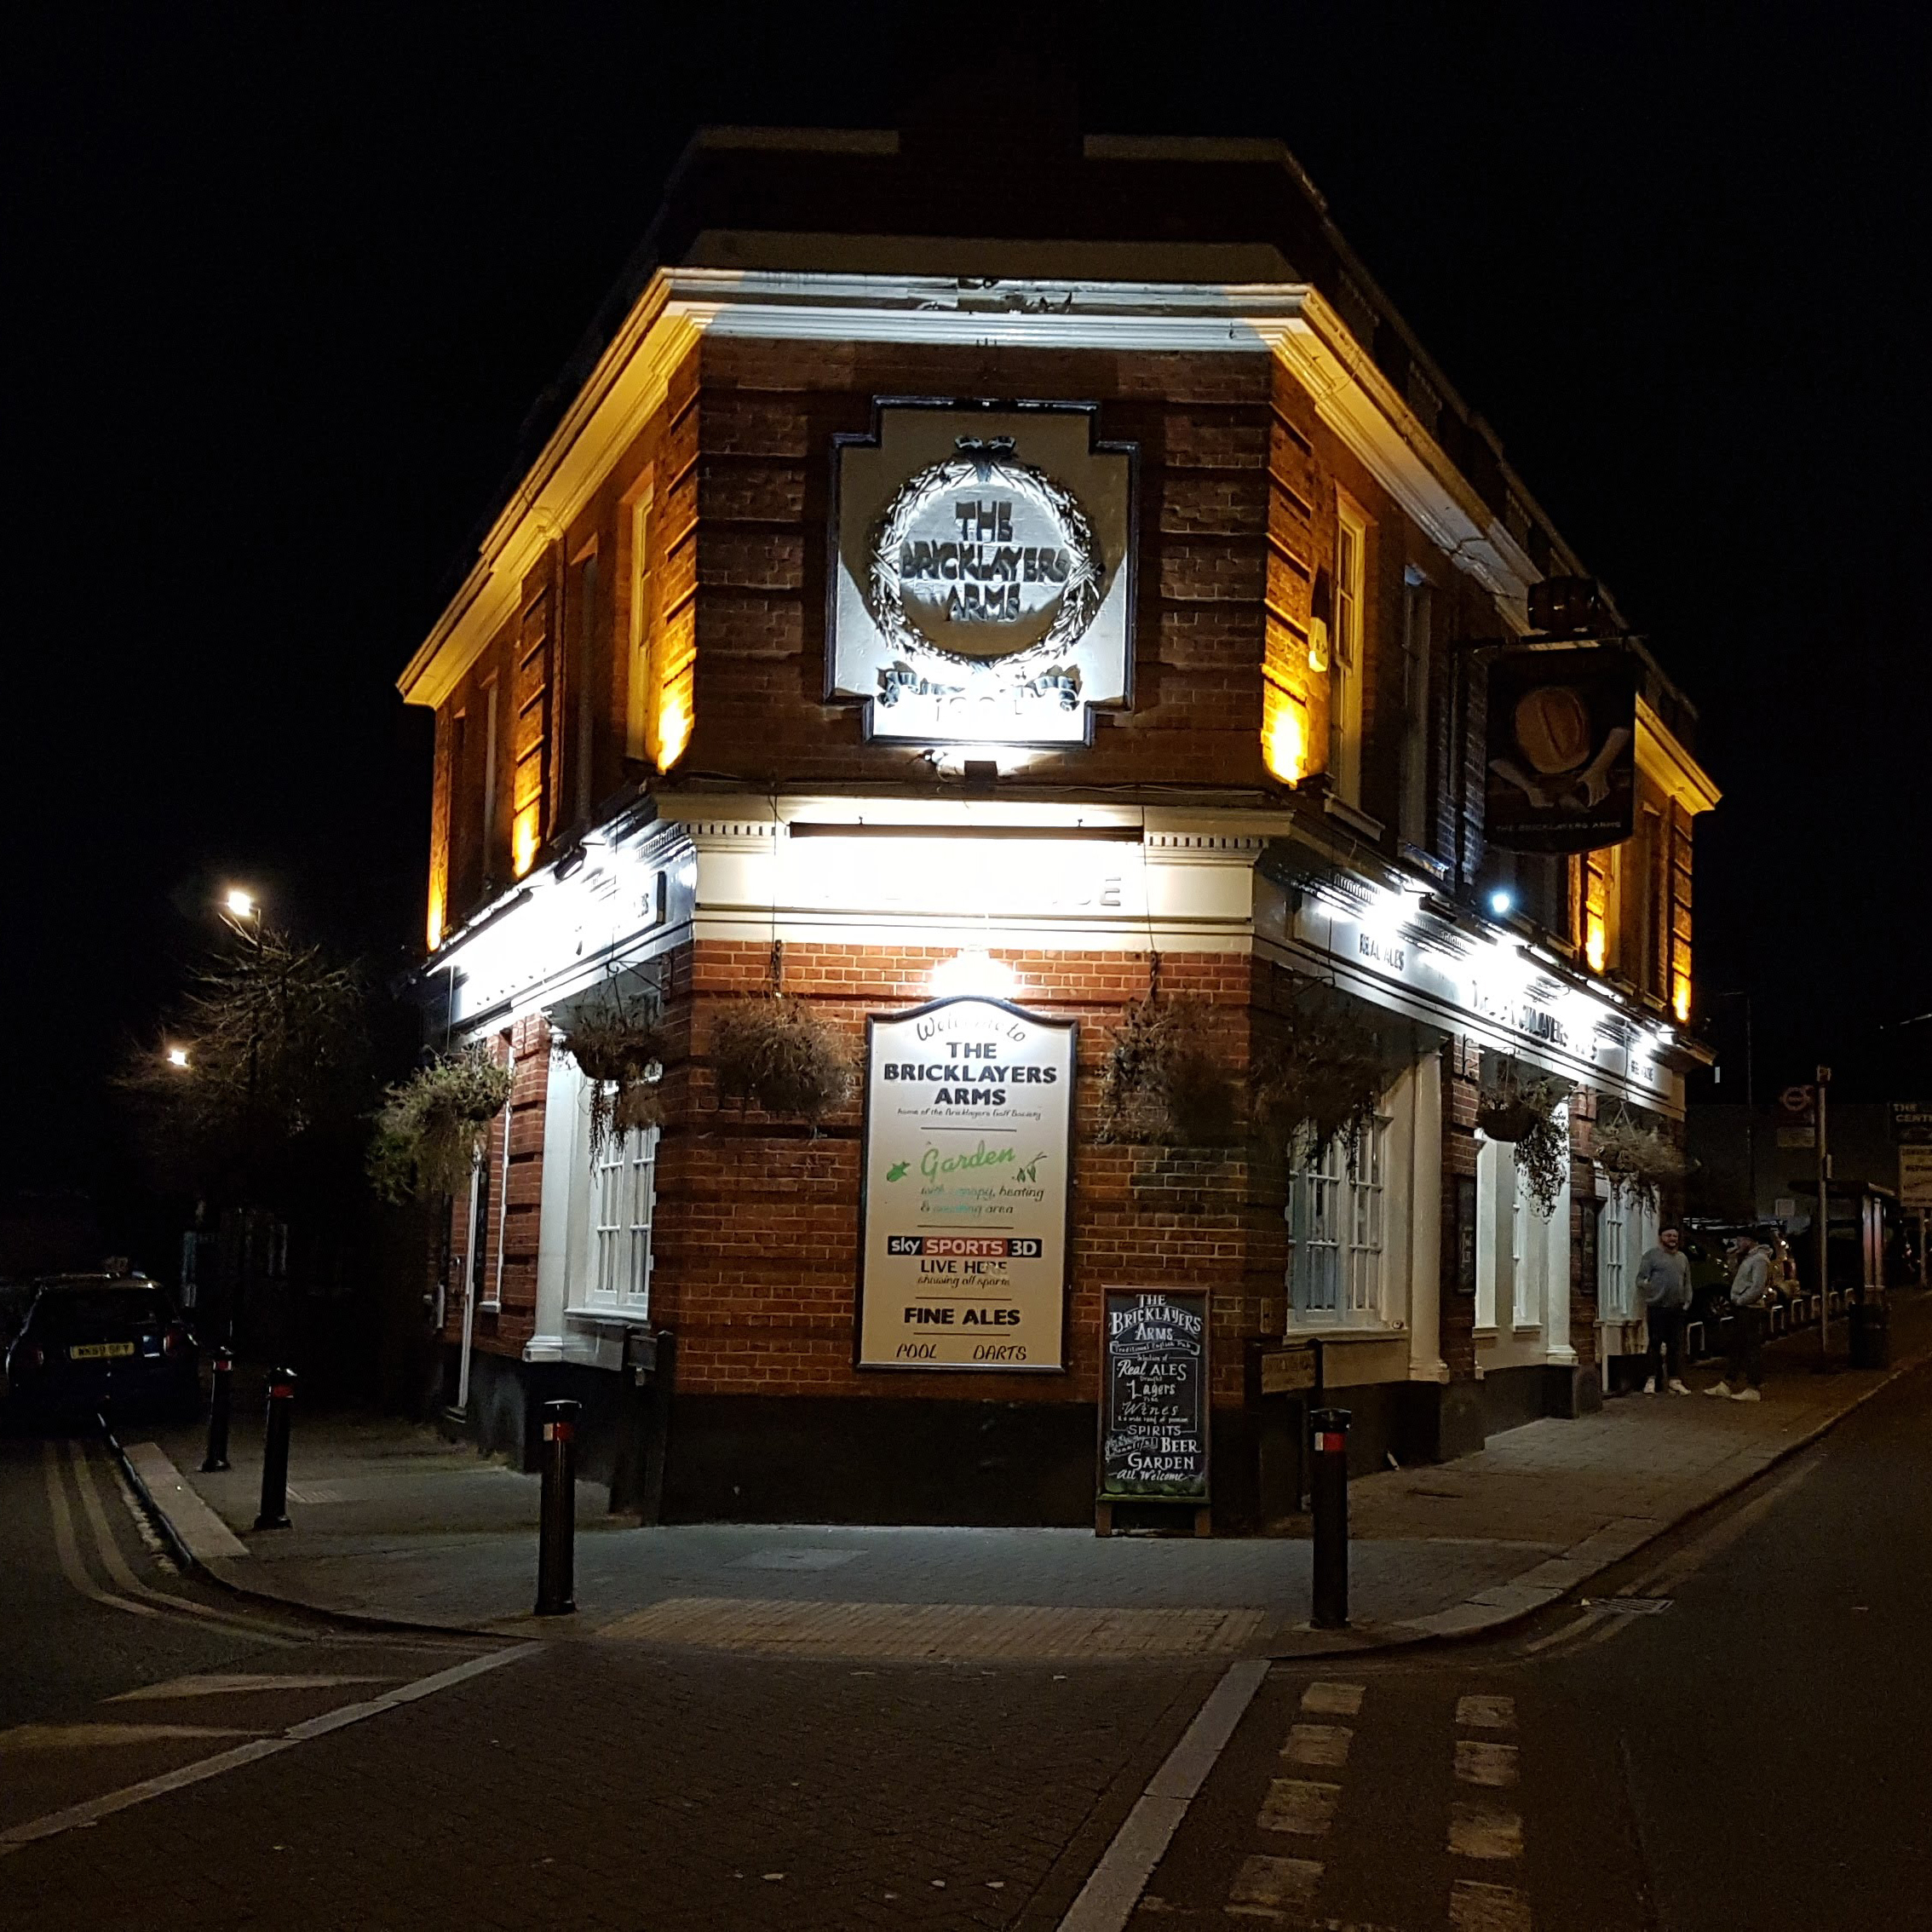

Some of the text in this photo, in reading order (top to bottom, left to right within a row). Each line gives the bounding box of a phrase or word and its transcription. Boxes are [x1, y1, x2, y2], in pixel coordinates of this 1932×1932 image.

[955, 500, 1013, 542] THE
[900, 539, 1069, 583] BRICKLAYERS
[946, 584, 1021, 622] ARMS
[1360, 934, 1404, 971] REAL ALES
[1006, 1022, 1026, 1042] to
[946, 1042, 997, 1059] THE
[884, 1063, 1057, 1084] BRICKLAYERS
[934, 1088, 1006, 1106] ARMS
[921, 1140, 1015, 1183] Garden
[999, 1185, 1044, 1202] heating
[985, 1205, 1014, 1214] area
[891, 1238, 1037, 1256] sky SPORTS 3D
[921, 1260, 957, 1274] LIVE
[918, 1274, 1009, 1289] showing all sports
[1136, 1294, 1167, 1308] THE
[905, 1308, 1021, 1325] FINE ALES
[1110, 1307, 1201, 1335] BRICKLAYERS
[1135, 1323, 1173, 1340] ARMS
[896, 1343, 1026, 1360] POOL DARTS
[1117, 1360, 1187, 1381] Real ALES
[1126, 1379, 1176, 1399] Lagers
[1123, 1401, 1178, 1416] Wines
[1128, 1424, 1181, 1436] SPIRITS
[1160, 1437, 1201, 1452] BEER
[1128, 1452, 1194, 1470] GARDEN
